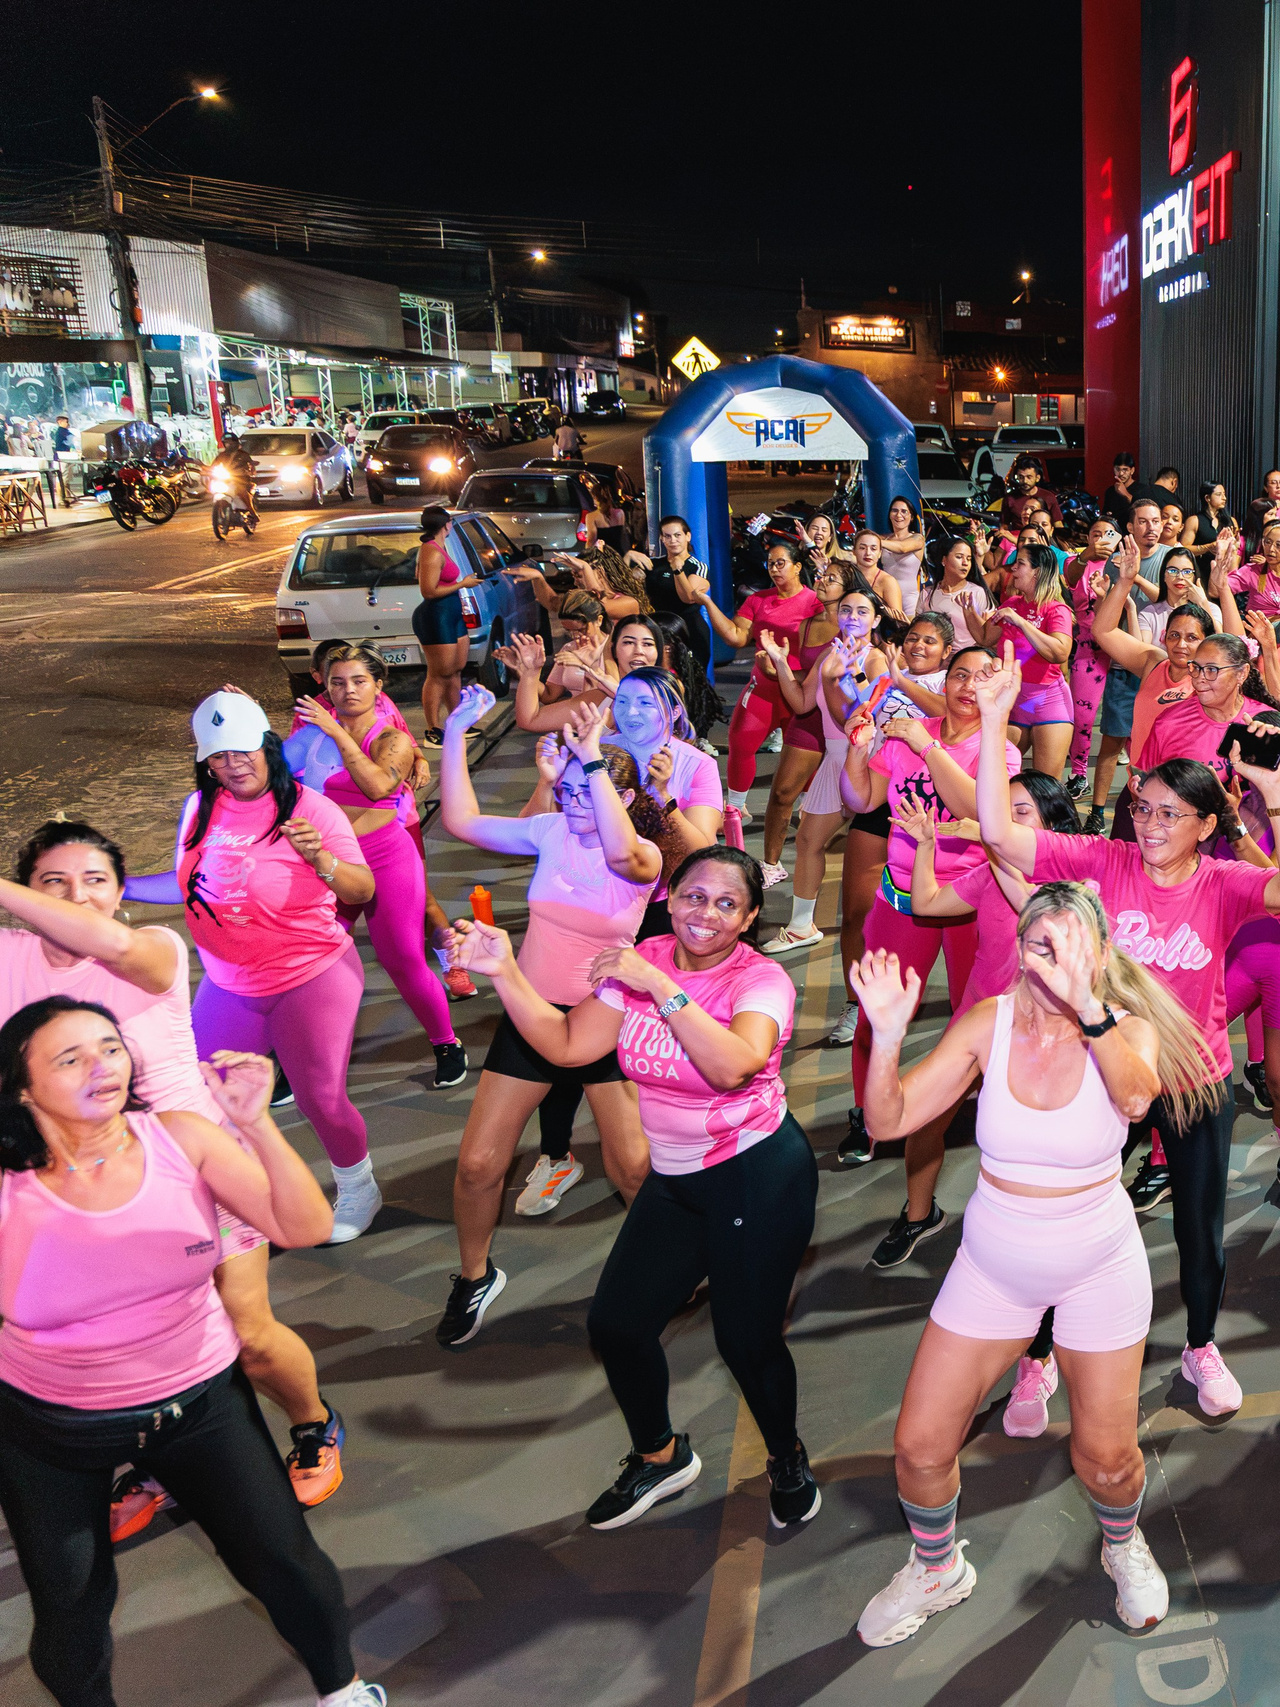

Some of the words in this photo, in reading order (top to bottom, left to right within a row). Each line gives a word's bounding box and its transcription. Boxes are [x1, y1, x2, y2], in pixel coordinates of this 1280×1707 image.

[1164, 690, 1186, 699] NIKE
[203, 834, 257, 848] DANÇA
[1111, 909, 1213, 972] Barbie
[625, 1054, 680, 1081] ROSA
